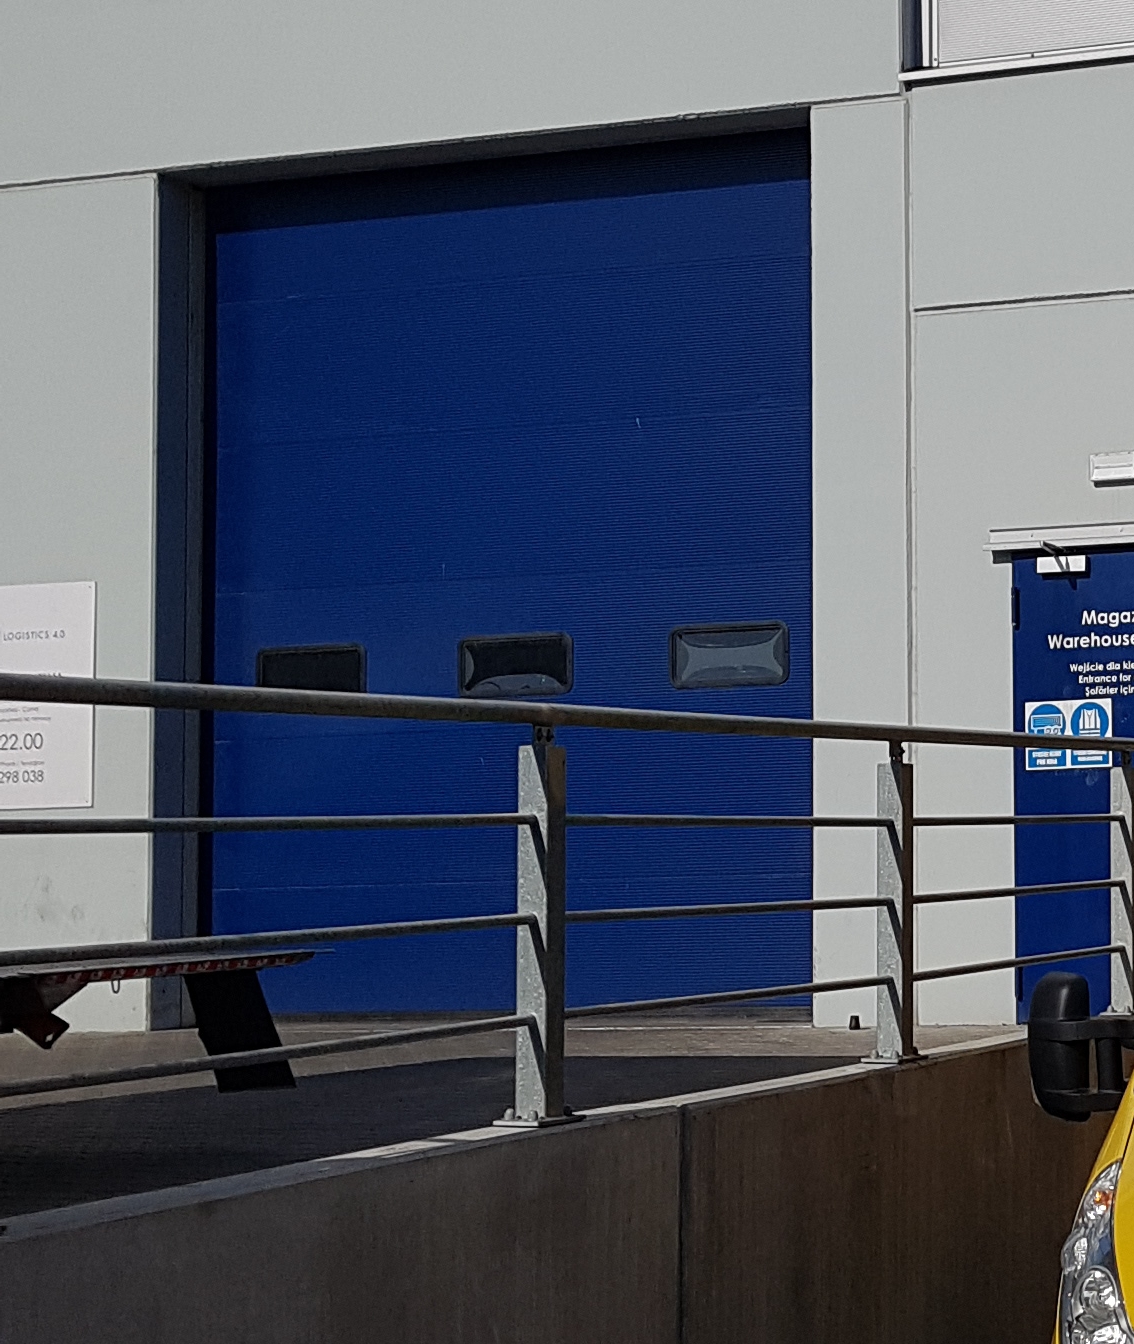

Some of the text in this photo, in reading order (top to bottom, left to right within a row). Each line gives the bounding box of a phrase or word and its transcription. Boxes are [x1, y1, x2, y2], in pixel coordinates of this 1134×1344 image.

[3, 630, 50, 642] LOGISTICS
[1069, 661, 1104, 674] Wejście
[1106, 661, 1121, 671] dla
[1078, 674, 1118, 684] Entrance
[1119, 672, 1132, 683] for
[22, 769, 45, 783] 038
